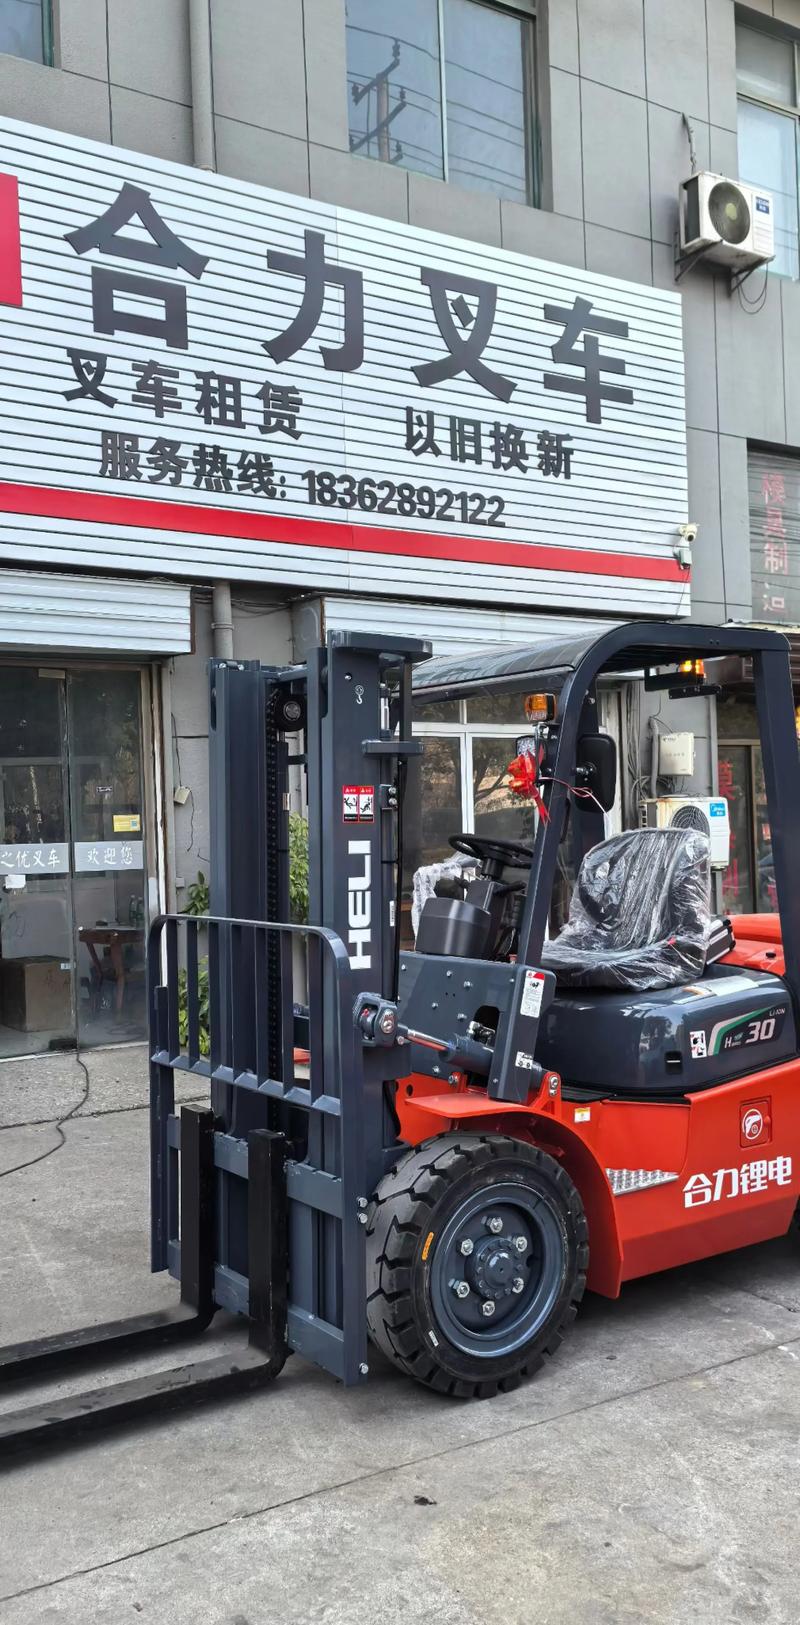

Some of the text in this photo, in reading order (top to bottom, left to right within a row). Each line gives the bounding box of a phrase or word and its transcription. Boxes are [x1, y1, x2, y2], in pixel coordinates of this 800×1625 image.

[63, 182, 634, 425] 合力叉车
[61, 347, 574, 480] 叉车租赁 以旧换新
[301, 469, 506, 527] 18362892122
[87, 846, 133, 865] 欢迎您
[348, 840, 371, 970] HELI
[745, 1018, 776, 1044] 30
[682, 1155, 792, 1208] 合力锂电
